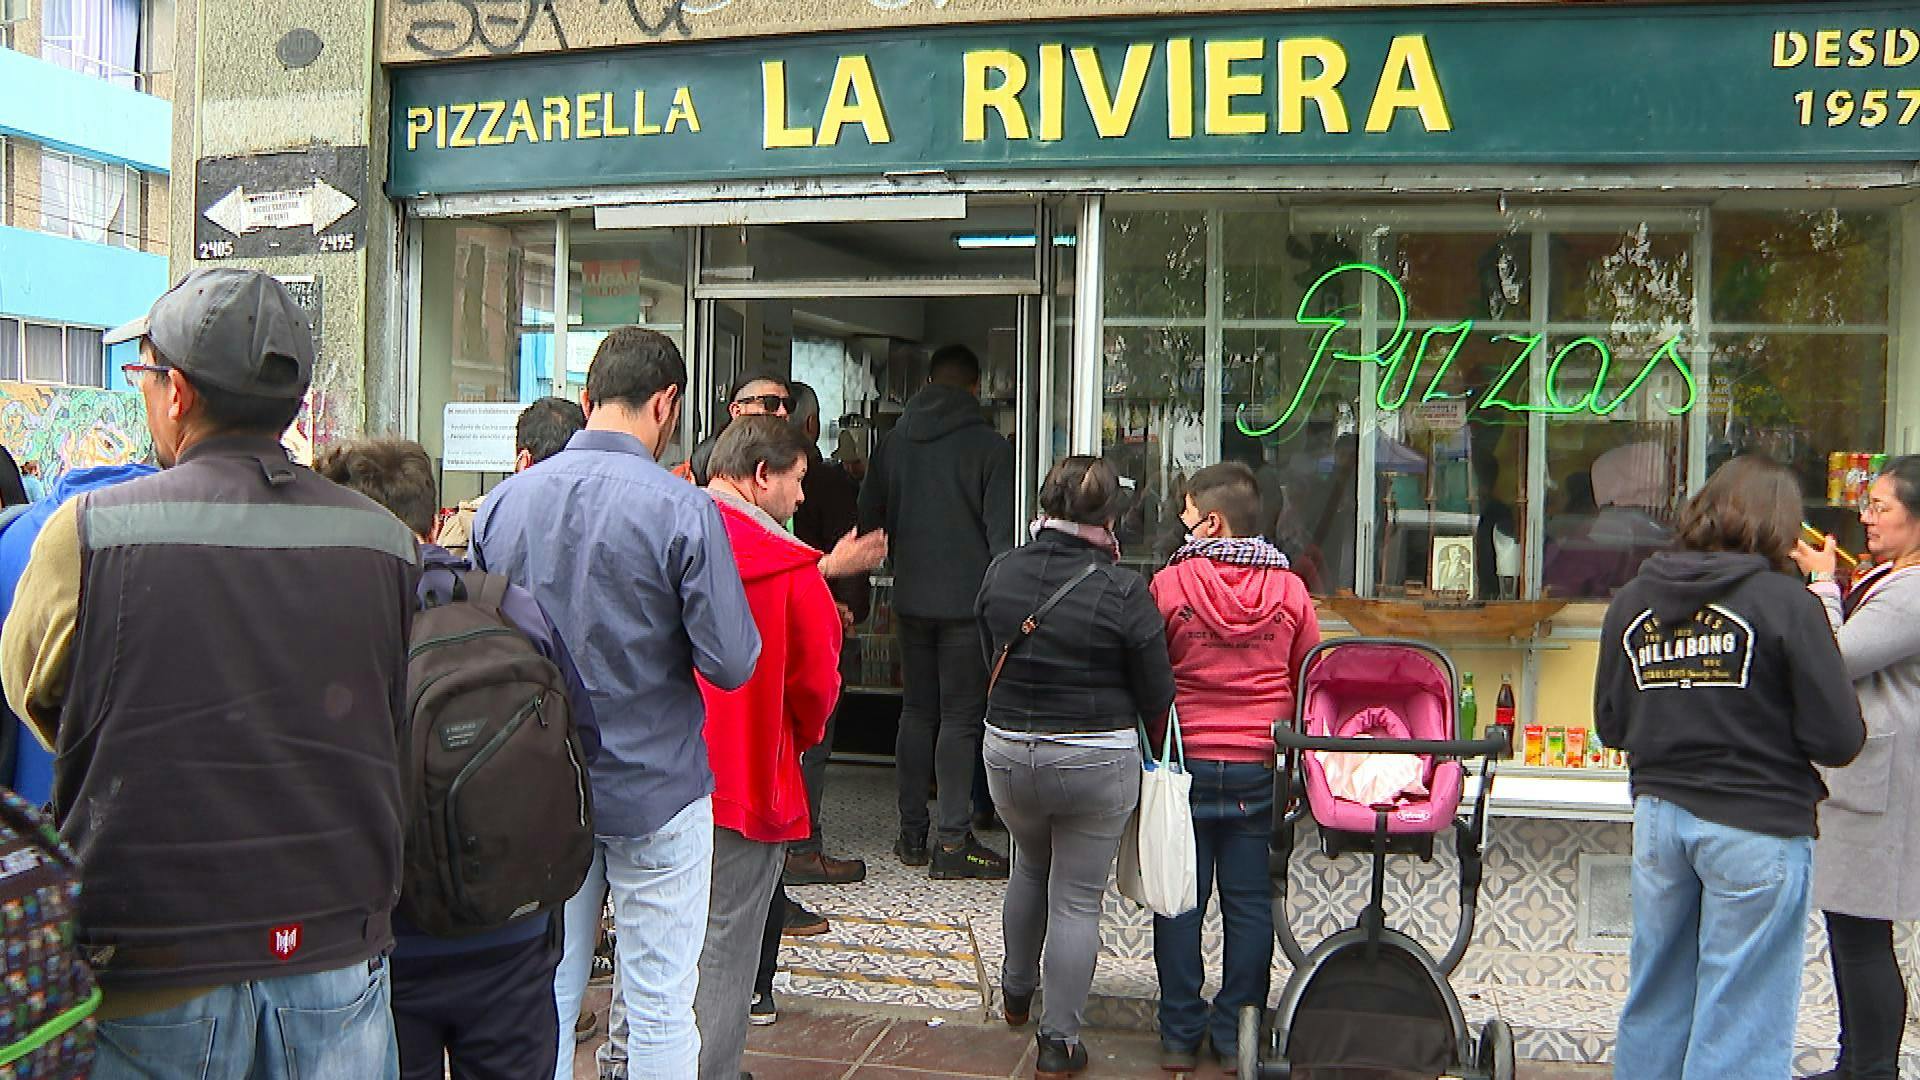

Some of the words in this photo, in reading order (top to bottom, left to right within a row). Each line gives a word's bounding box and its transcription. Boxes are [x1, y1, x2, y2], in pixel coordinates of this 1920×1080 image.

[1773, 29, 1920, 68] DESD
[764, 56, 890, 149] LA
[963, 34, 1452, 142] RIVIERA
[1795, 89, 1920, 127] 1957
[408, 87, 701, 150] PIZZARELLA
[200, 240, 233, 258] 2405
[319, 233, 354, 252] 2495
[1236, 262, 1697, 437] Pizzas
[1639, 632, 1736, 667] BILLABONG
